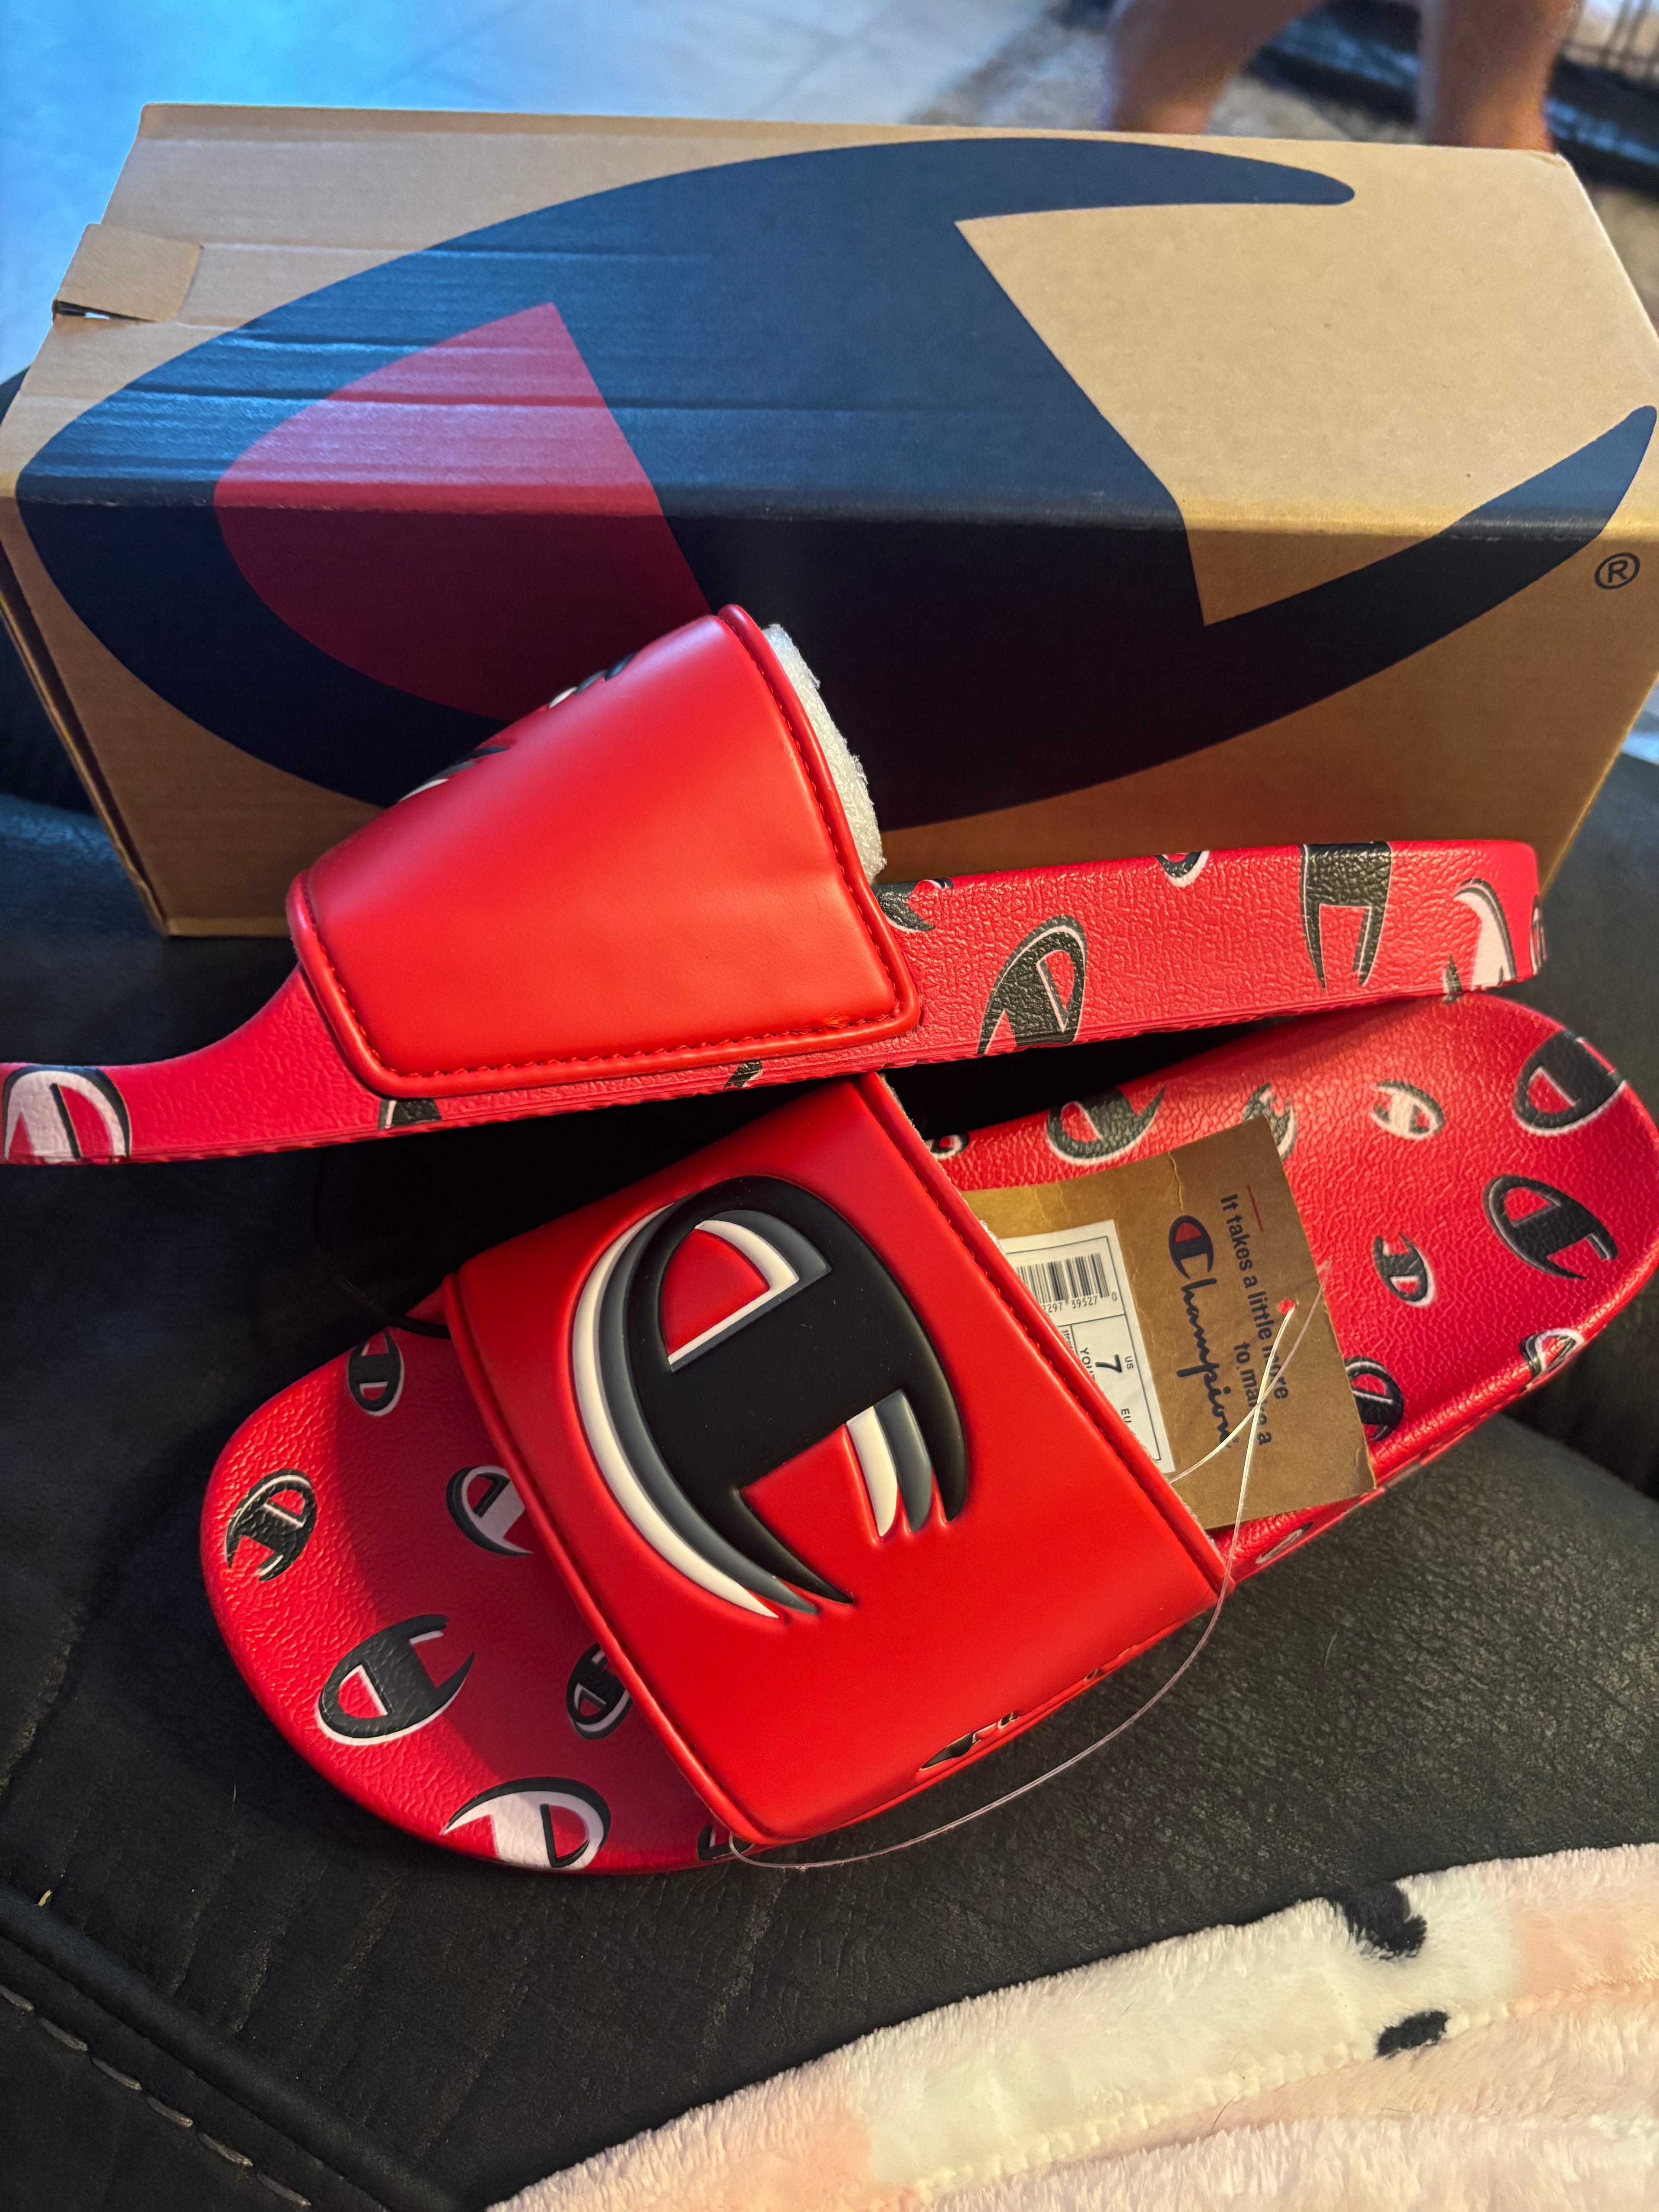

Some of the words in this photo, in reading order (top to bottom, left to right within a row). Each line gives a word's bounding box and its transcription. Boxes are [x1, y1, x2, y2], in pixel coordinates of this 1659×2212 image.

[1220, 1194, 1238, 1211] It
[1226, 1214, 1252, 1271] takes
[1243, 1275, 1258, 1289] a
[1071, 1296, 1098, 1309] 39527
[1111, 1292, 1118, 1301] 0
[1248, 1290, 1274, 1340] little
[1095, 1354, 1122, 1373] 7
[1125, 1356, 1134, 1370] US
[1233, 1341, 1250, 1363] to
[1257, 1431, 1271, 1446] a
[1121, 1408, 1132, 1424] EU
